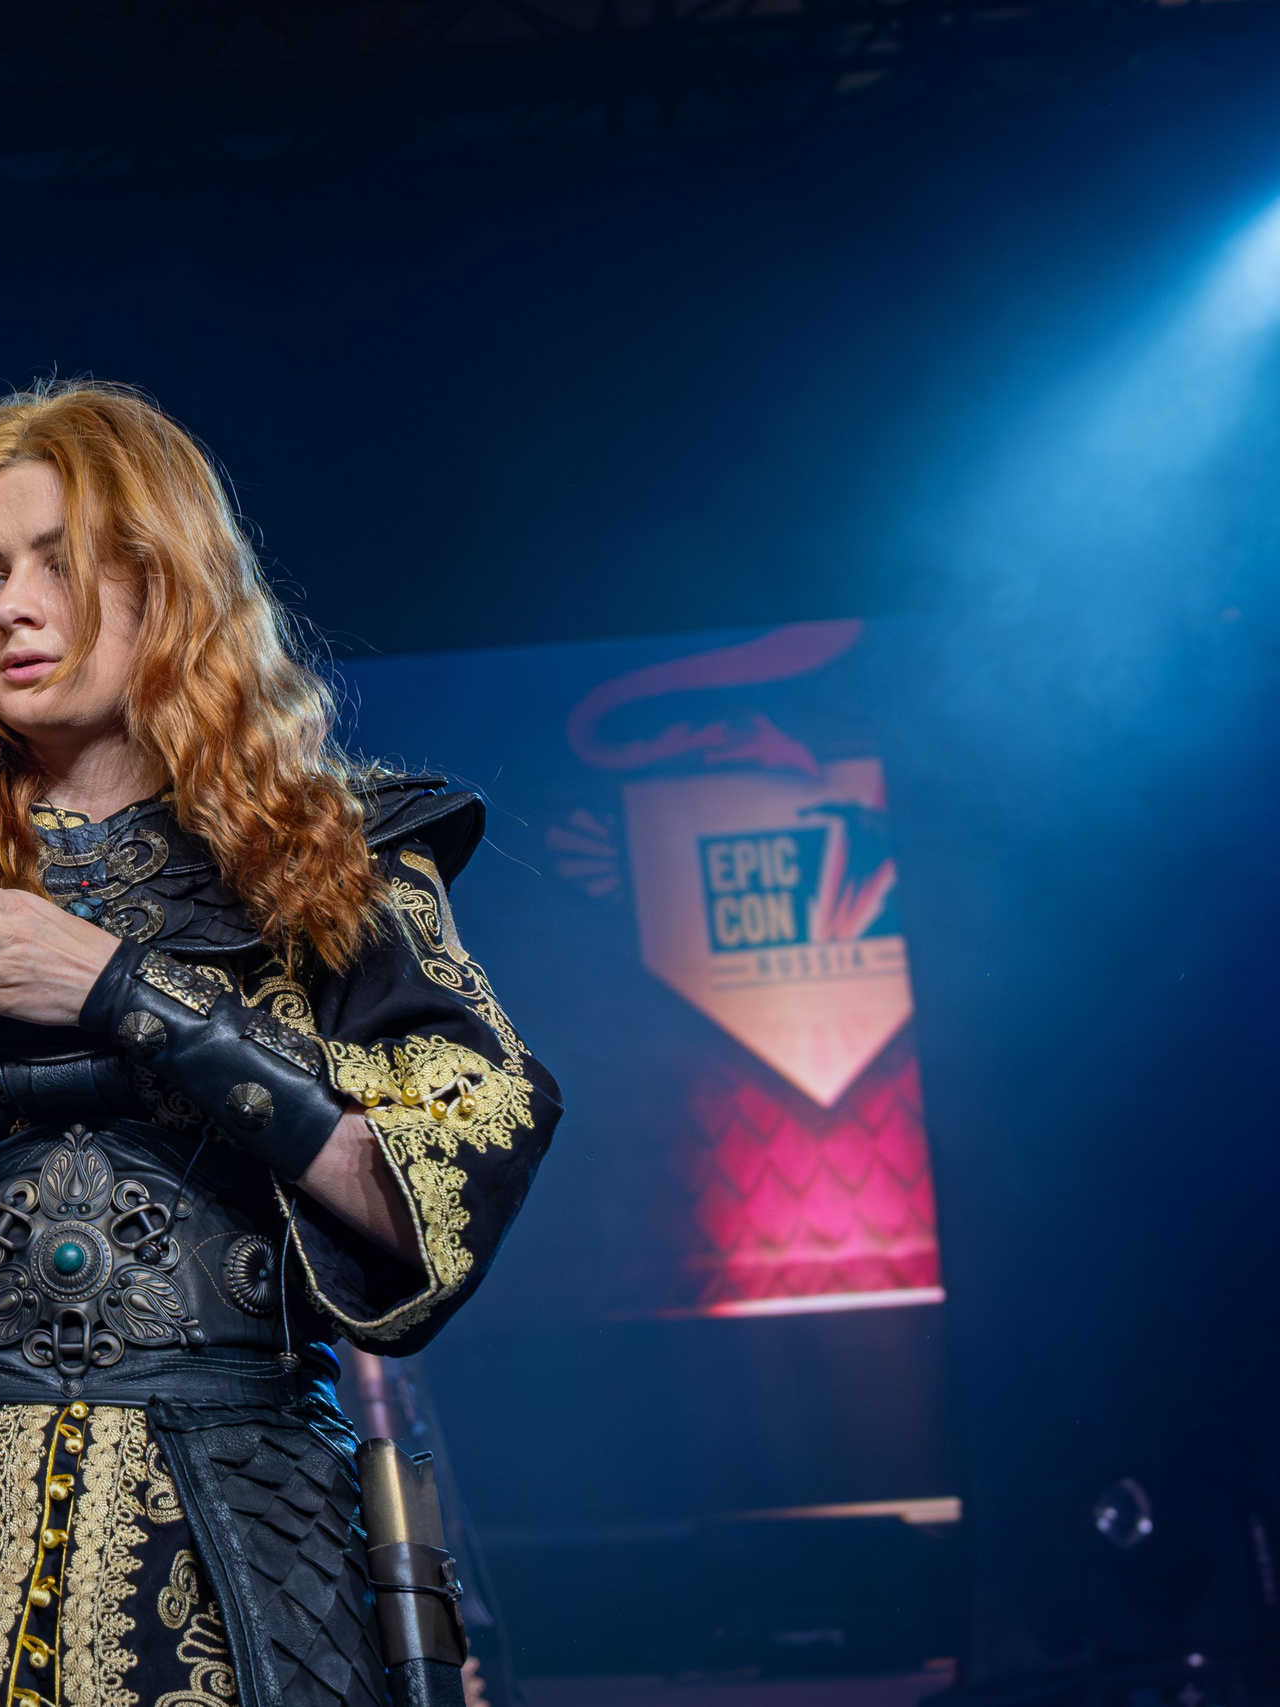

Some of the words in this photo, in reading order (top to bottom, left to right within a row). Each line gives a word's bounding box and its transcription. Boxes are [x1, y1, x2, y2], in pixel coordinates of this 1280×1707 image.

[708, 838, 800, 892] EPIC
[714, 892, 797, 946] CON
[756, 945, 866, 978] RUSSIA
